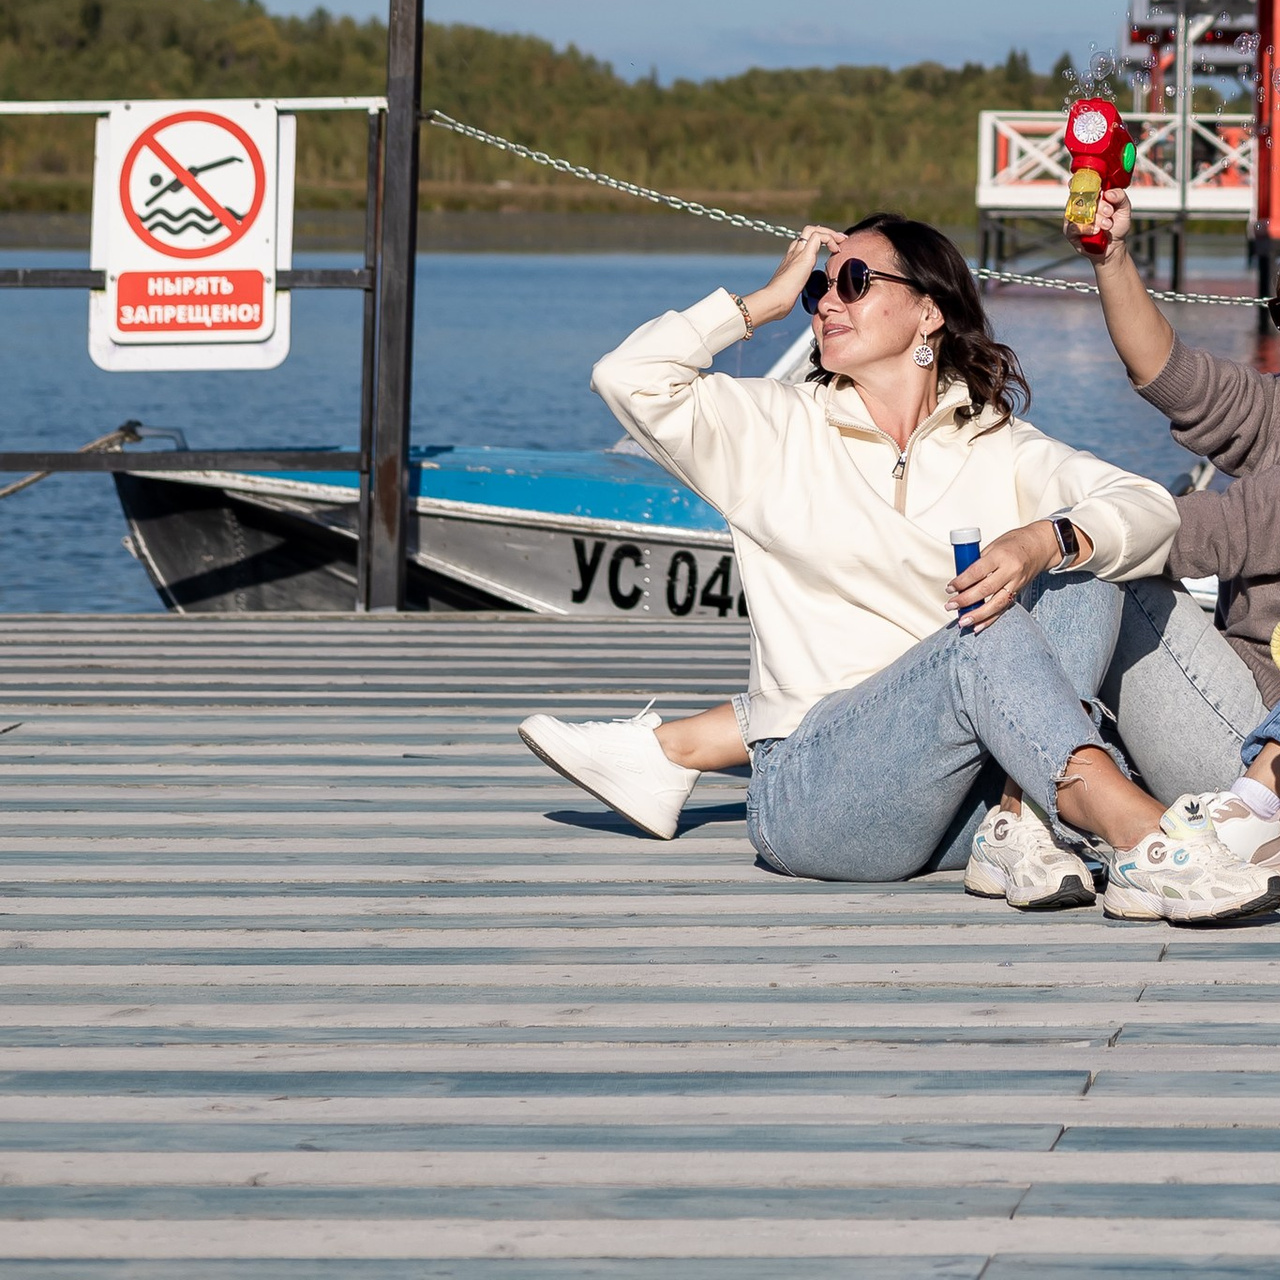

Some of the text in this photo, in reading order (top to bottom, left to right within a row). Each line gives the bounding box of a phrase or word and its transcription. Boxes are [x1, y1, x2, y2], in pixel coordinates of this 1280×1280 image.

[147, 276, 234, 296] НЫРЯТЬ
[119, 303, 261, 328] ЗАПРЕЩЕНО!
[1187, 814, 1204, 822] adidas
